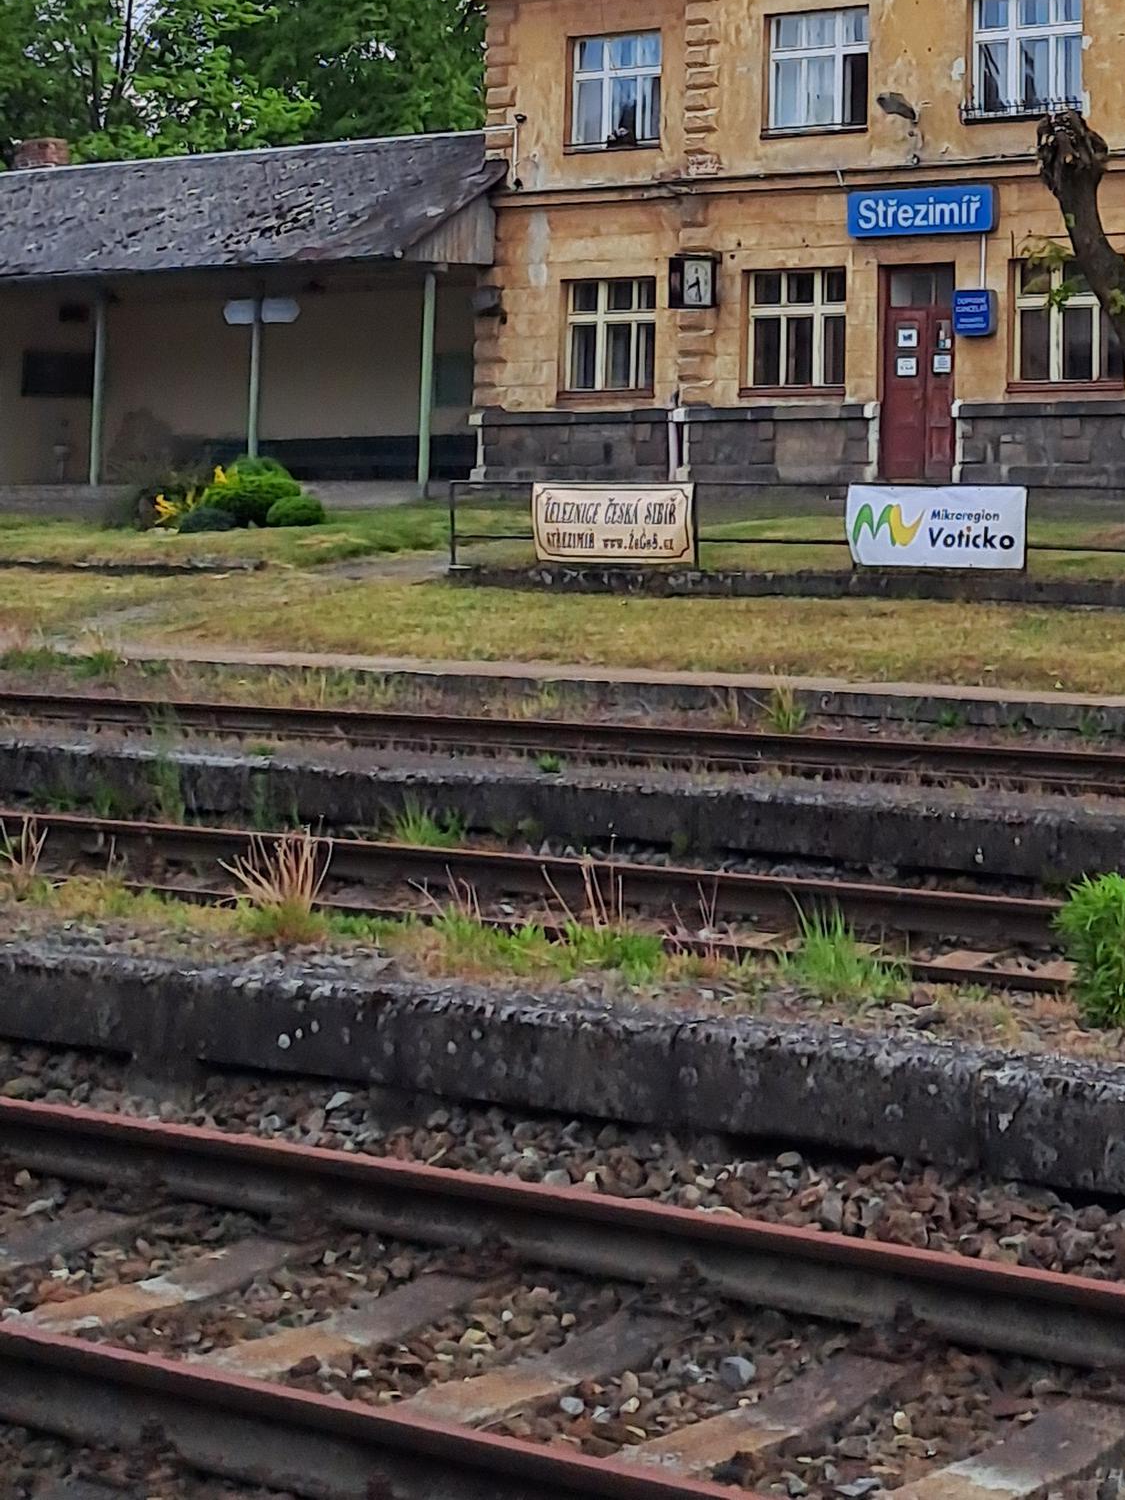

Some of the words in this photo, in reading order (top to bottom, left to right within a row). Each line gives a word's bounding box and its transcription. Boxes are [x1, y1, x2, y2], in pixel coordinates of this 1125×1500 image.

[857, 194, 981, 230] Střezimíř
[544, 496, 601, 524] ŽELEZNICE
[604, 497, 642, 525] ČESKÁ
[930, 509, 1000, 524] Mikroregion
[928, 526, 1015, 550] Voticko
